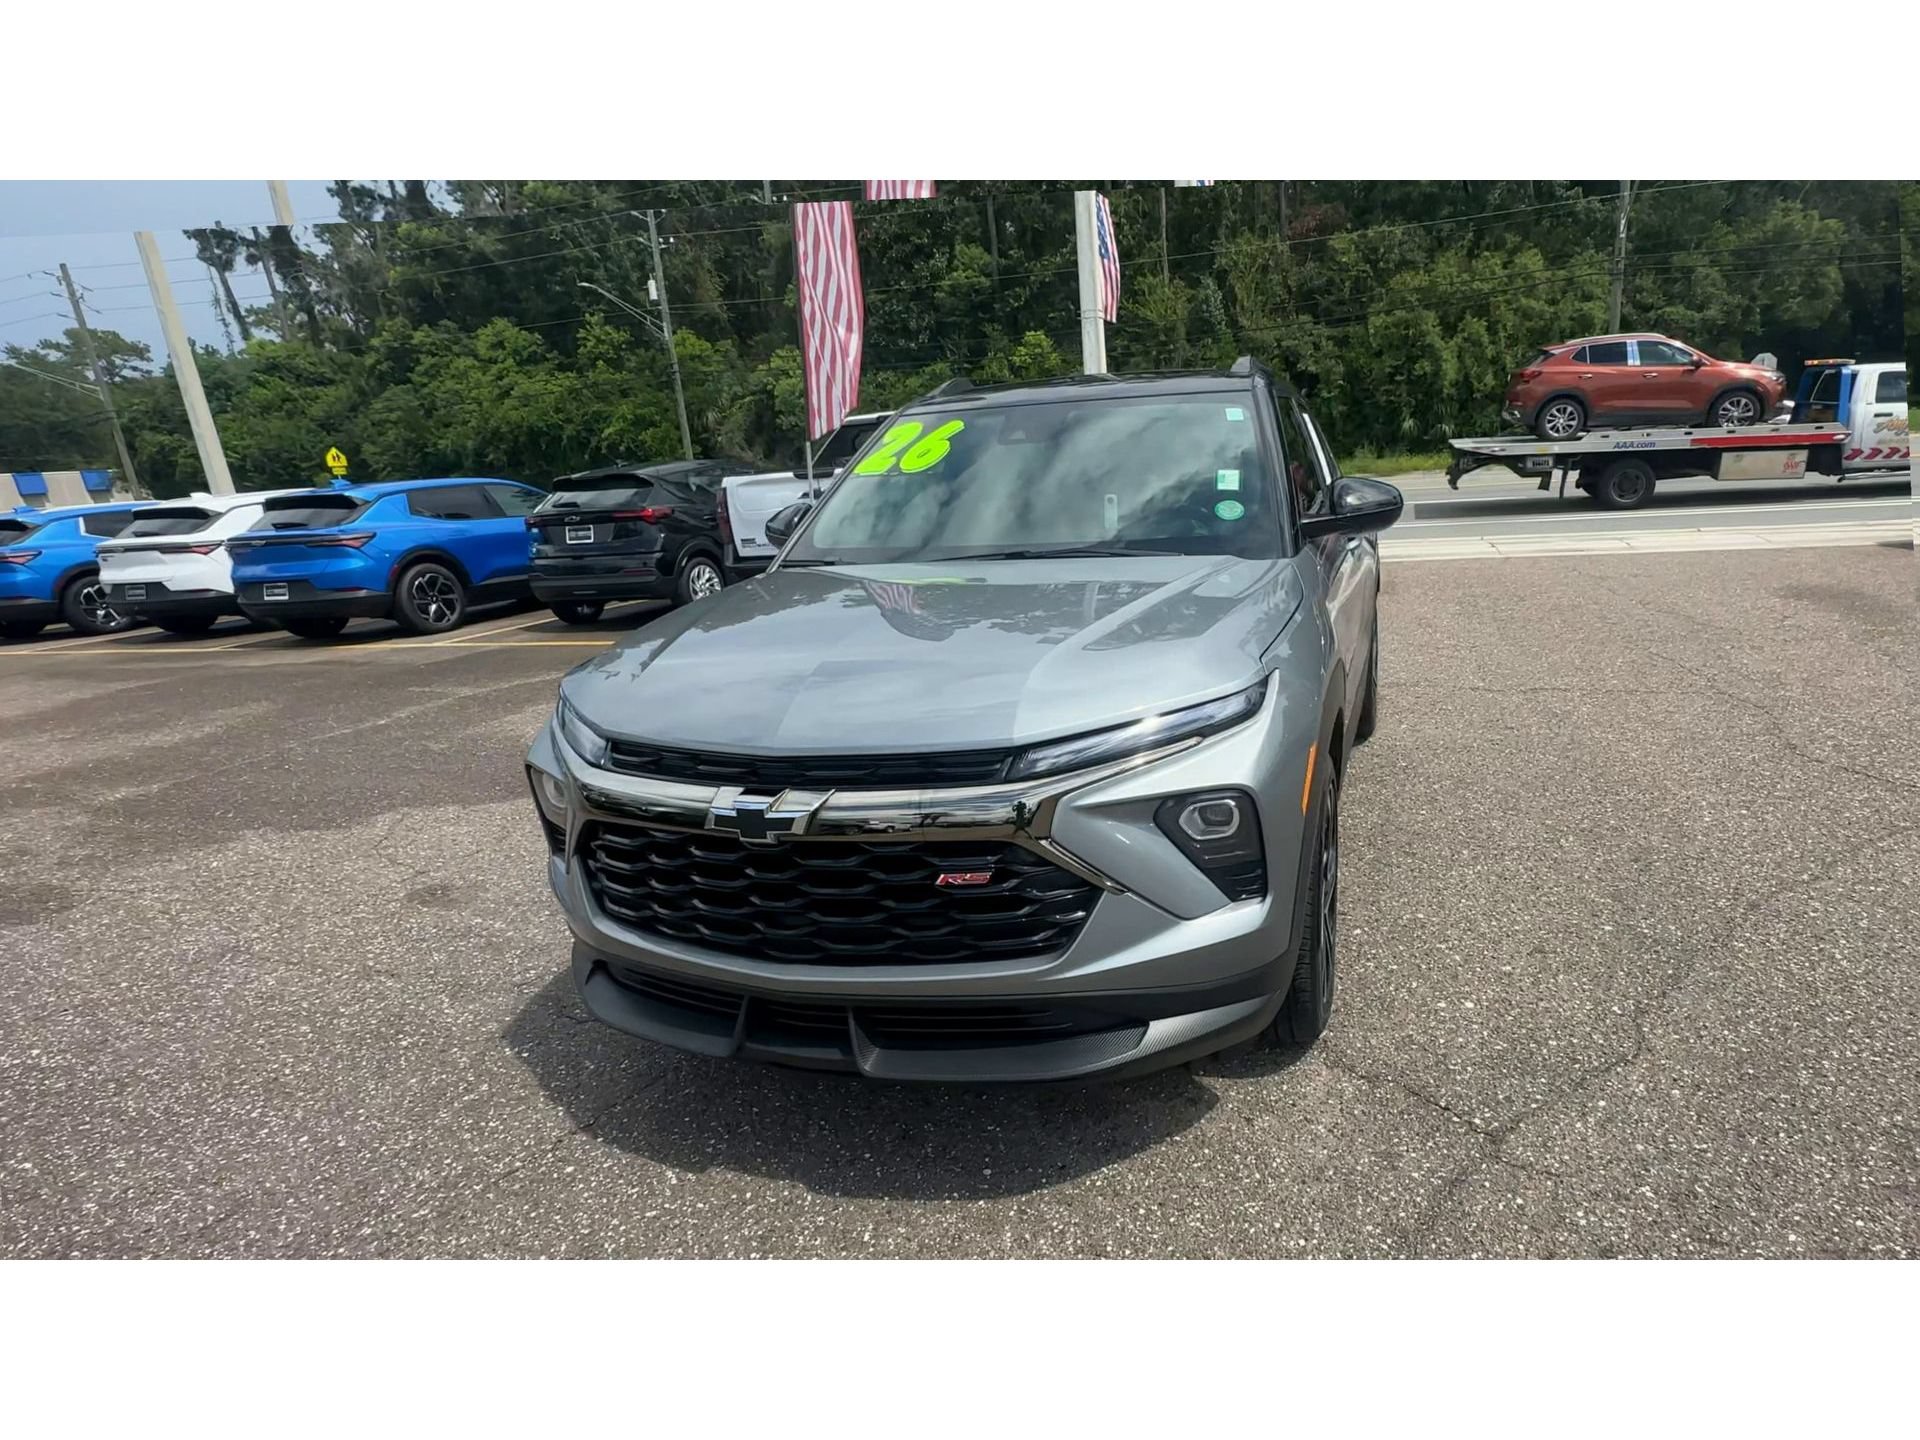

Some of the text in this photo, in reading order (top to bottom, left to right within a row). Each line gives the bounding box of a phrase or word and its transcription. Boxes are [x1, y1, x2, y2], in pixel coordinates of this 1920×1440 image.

[853, 420, 965, 475] 26
[1613, 440, 1656, 449] AAA.com
[935, 872, 992, 885] RS
